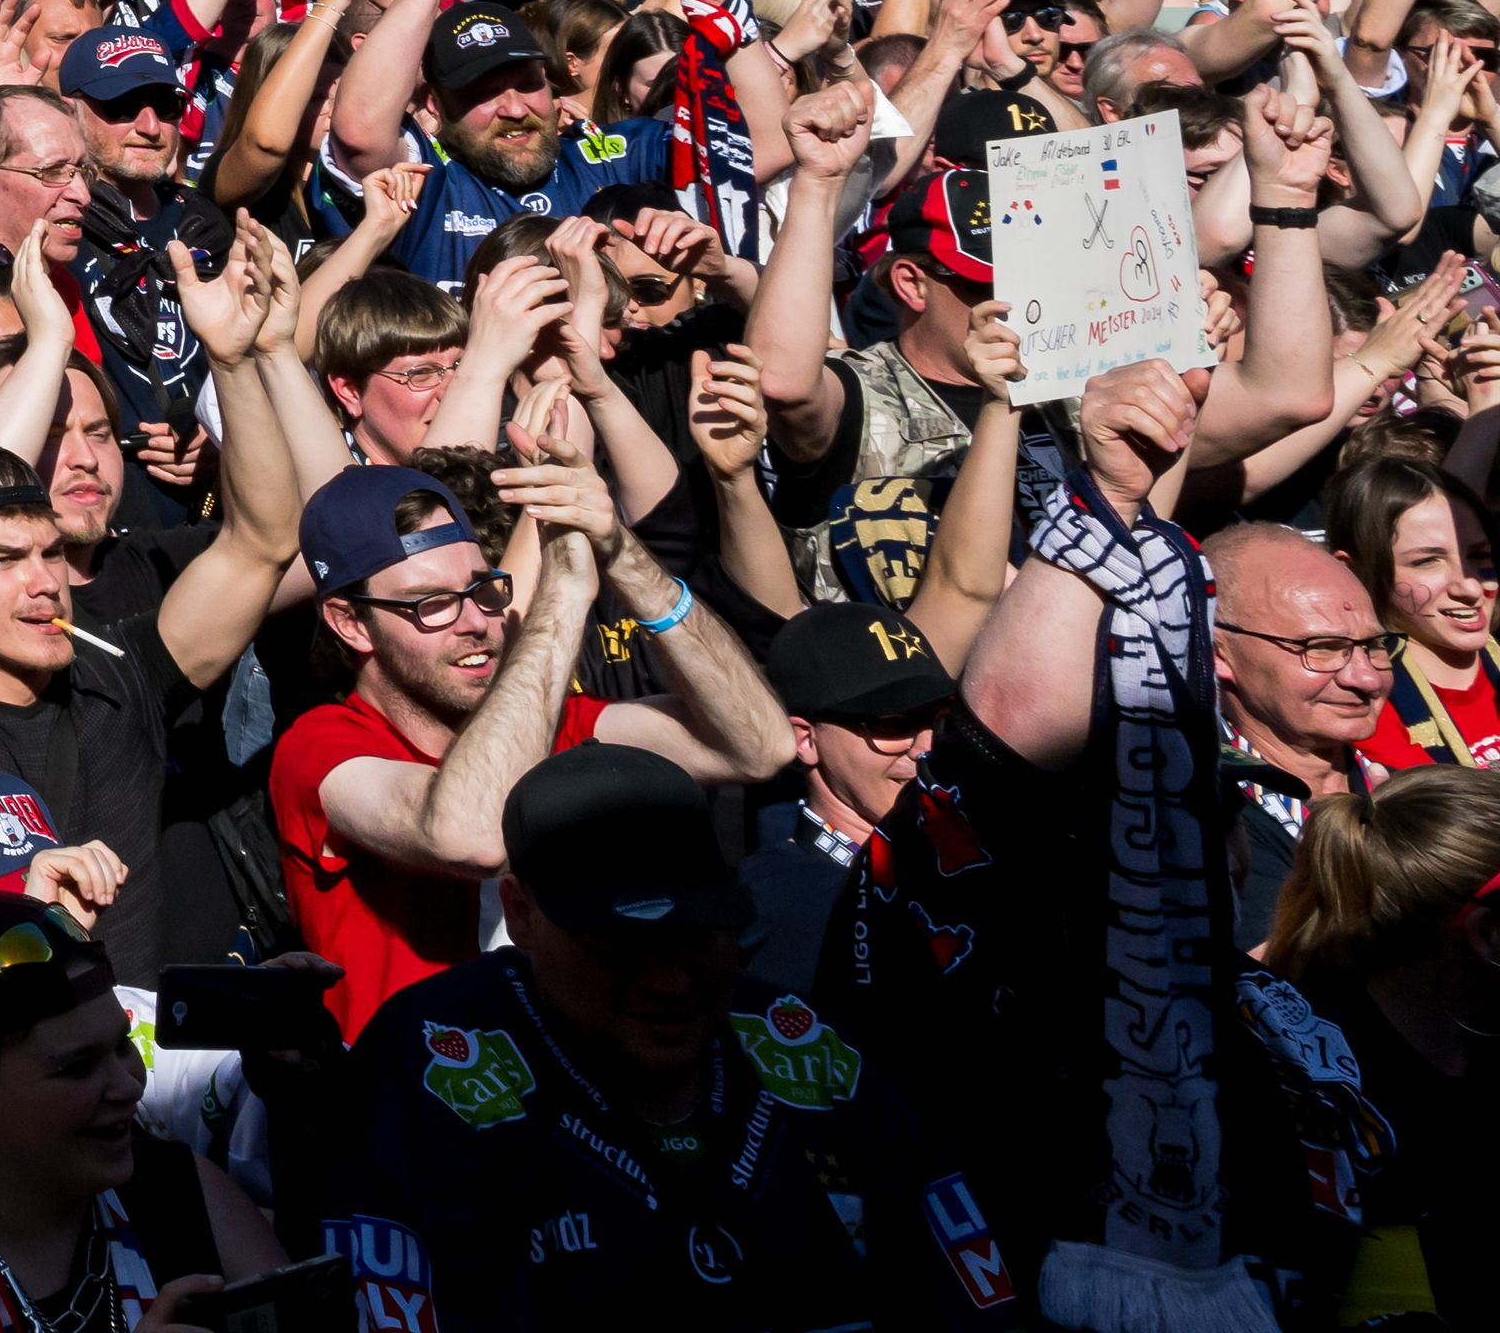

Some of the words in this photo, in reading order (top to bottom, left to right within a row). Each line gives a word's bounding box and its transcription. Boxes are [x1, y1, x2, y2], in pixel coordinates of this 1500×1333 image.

[1007, 103, 1023, 131] 1
[1088, 309, 1138, 346] MEISTER
[1141, 306, 1163, 325] 2024
[868, 621, 898, 661] 1
[738, 1029, 848, 1090] Karls
